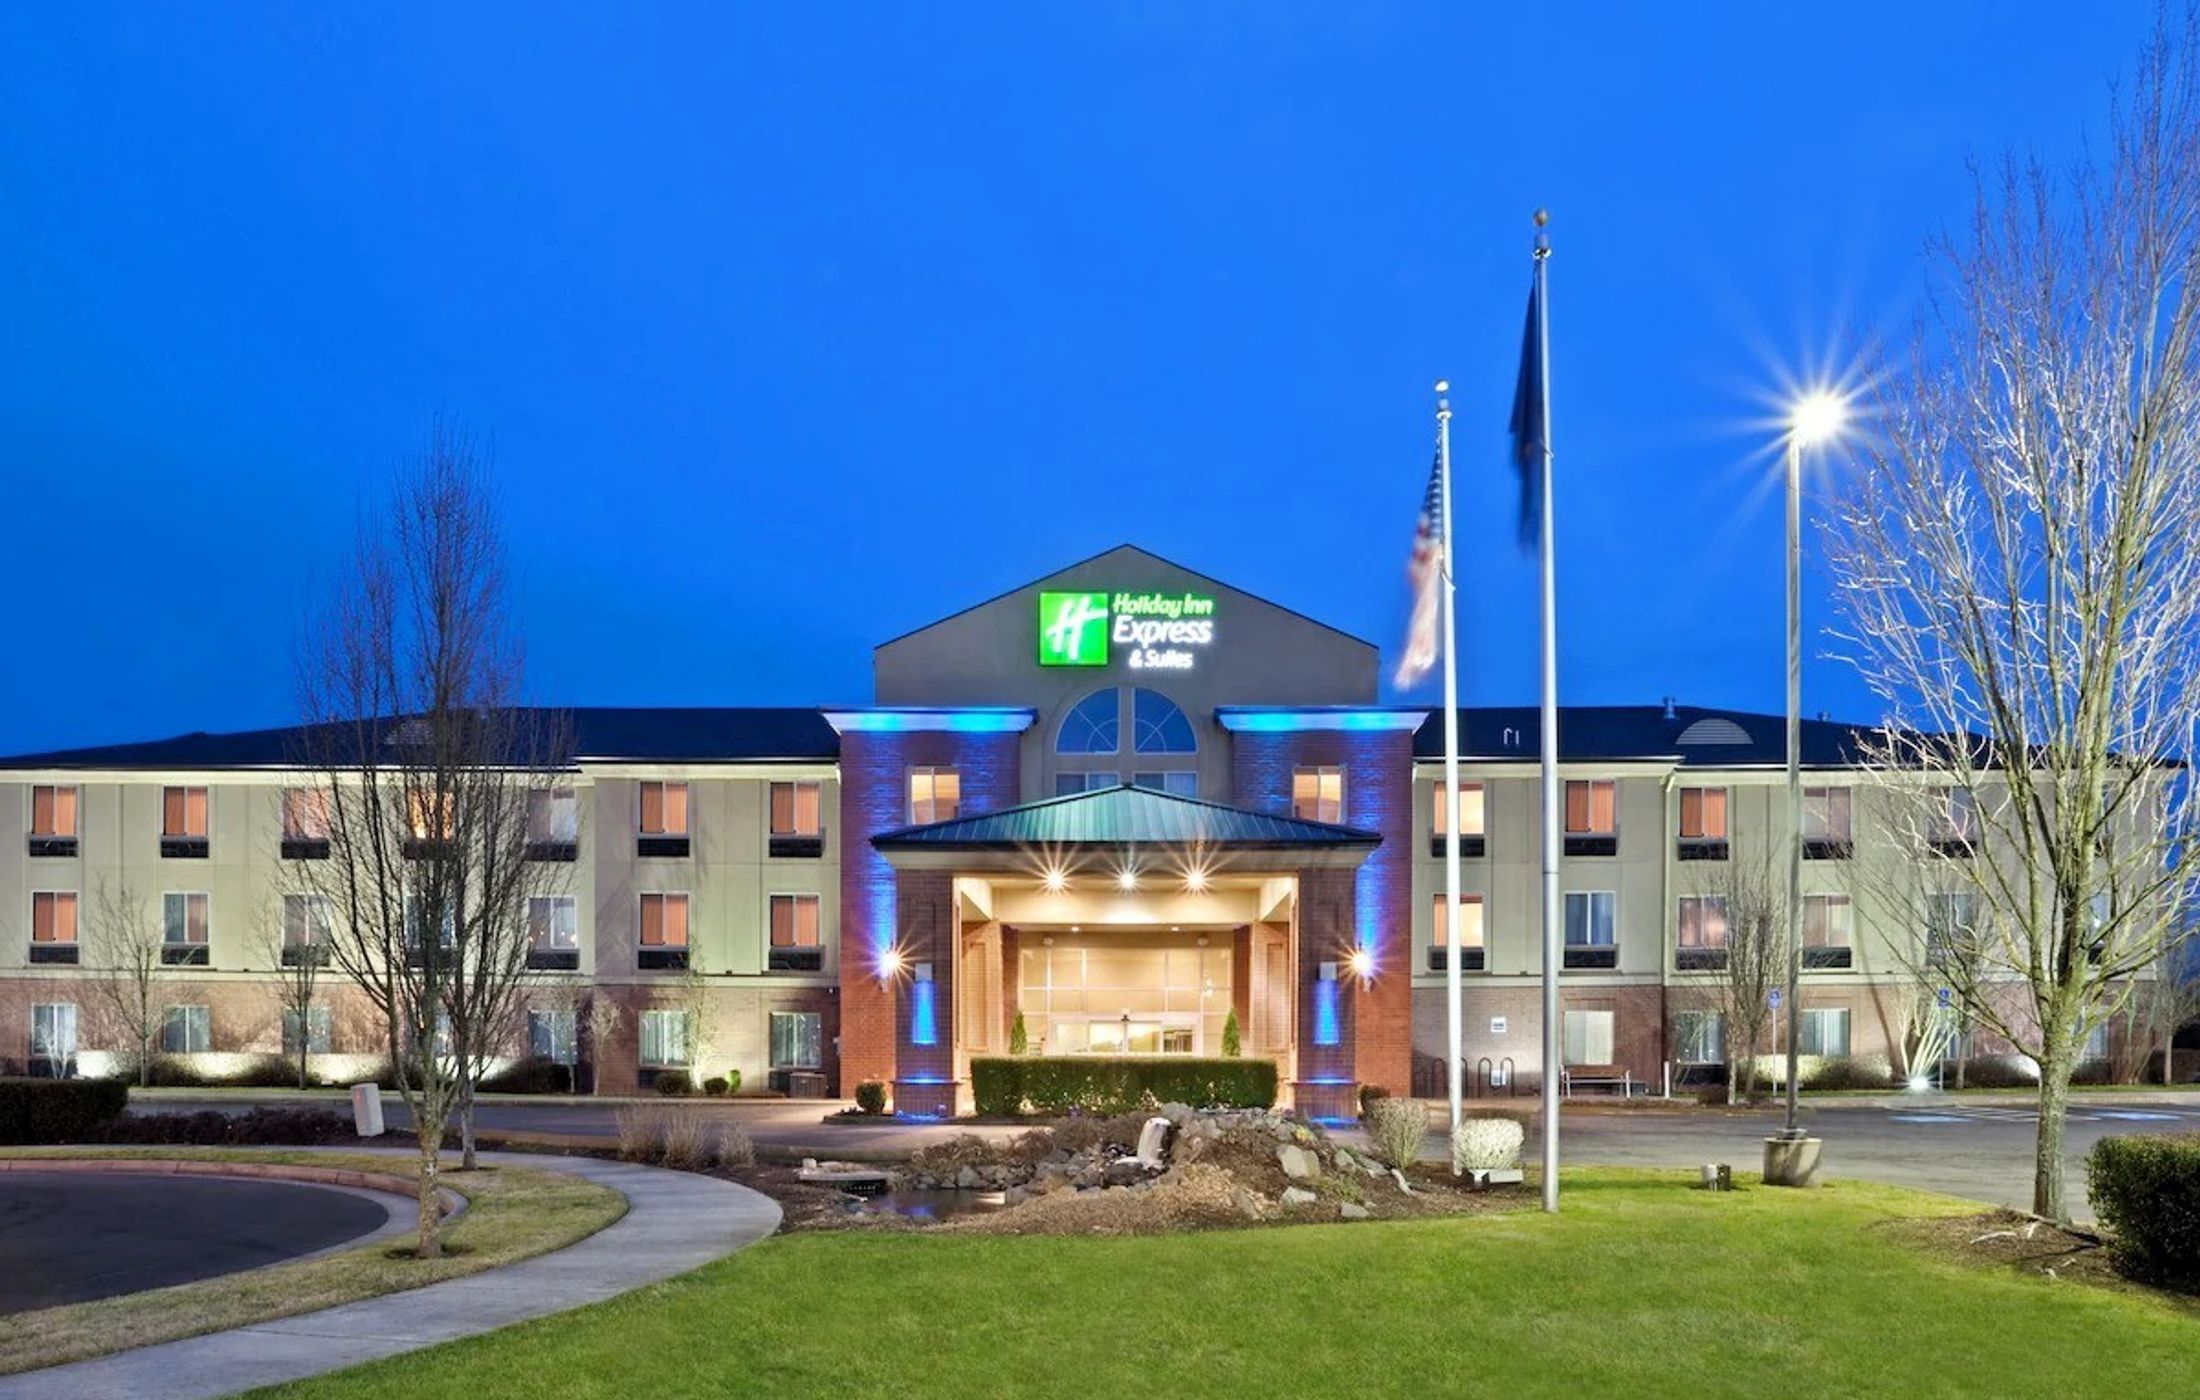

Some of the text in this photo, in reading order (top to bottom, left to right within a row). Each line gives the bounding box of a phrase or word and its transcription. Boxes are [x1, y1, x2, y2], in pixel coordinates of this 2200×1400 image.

[1113, 593, 1213, 618] Holiday Inn
[1113, 615, 1213, 648] Express
[1129, 650, 1193, 668] & Suites
